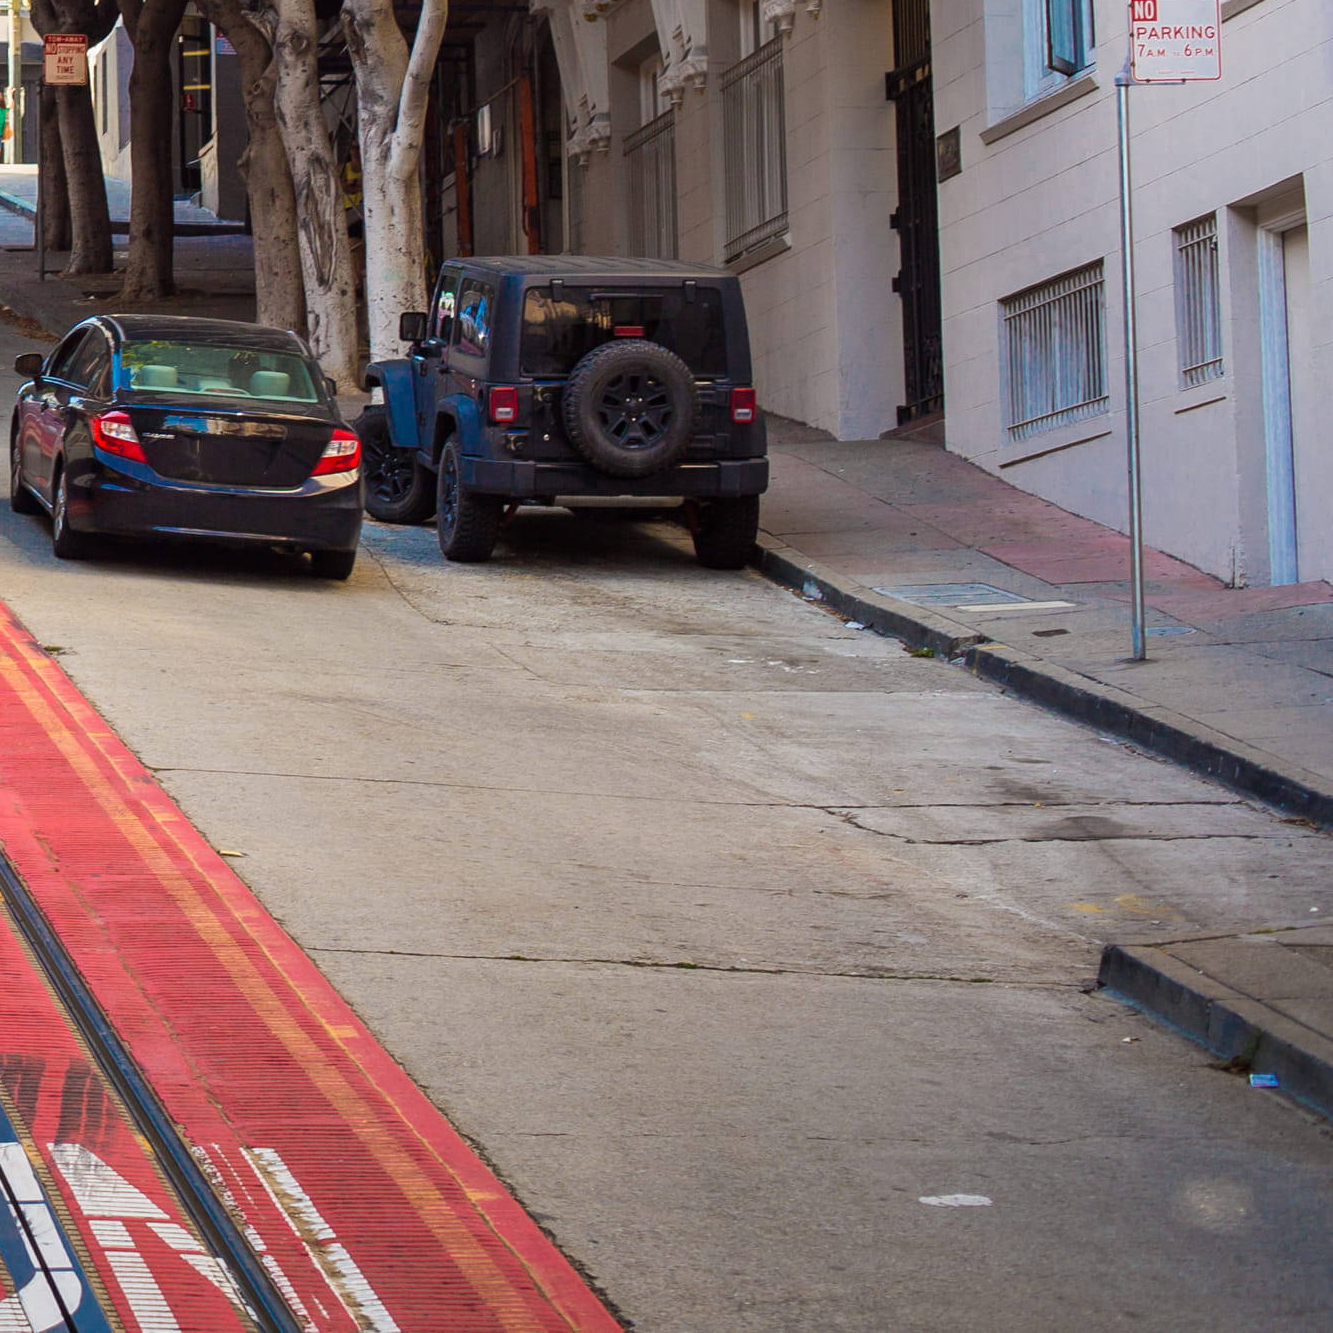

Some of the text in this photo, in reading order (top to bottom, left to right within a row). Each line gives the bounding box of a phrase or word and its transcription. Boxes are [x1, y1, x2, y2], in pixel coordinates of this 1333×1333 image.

[1134, 0, 1154, 19] NO
[1136, 26, 1215, 40] PARKING
[45, 43, 57, 54] NO
[56, 65, 75, 74] TIME
